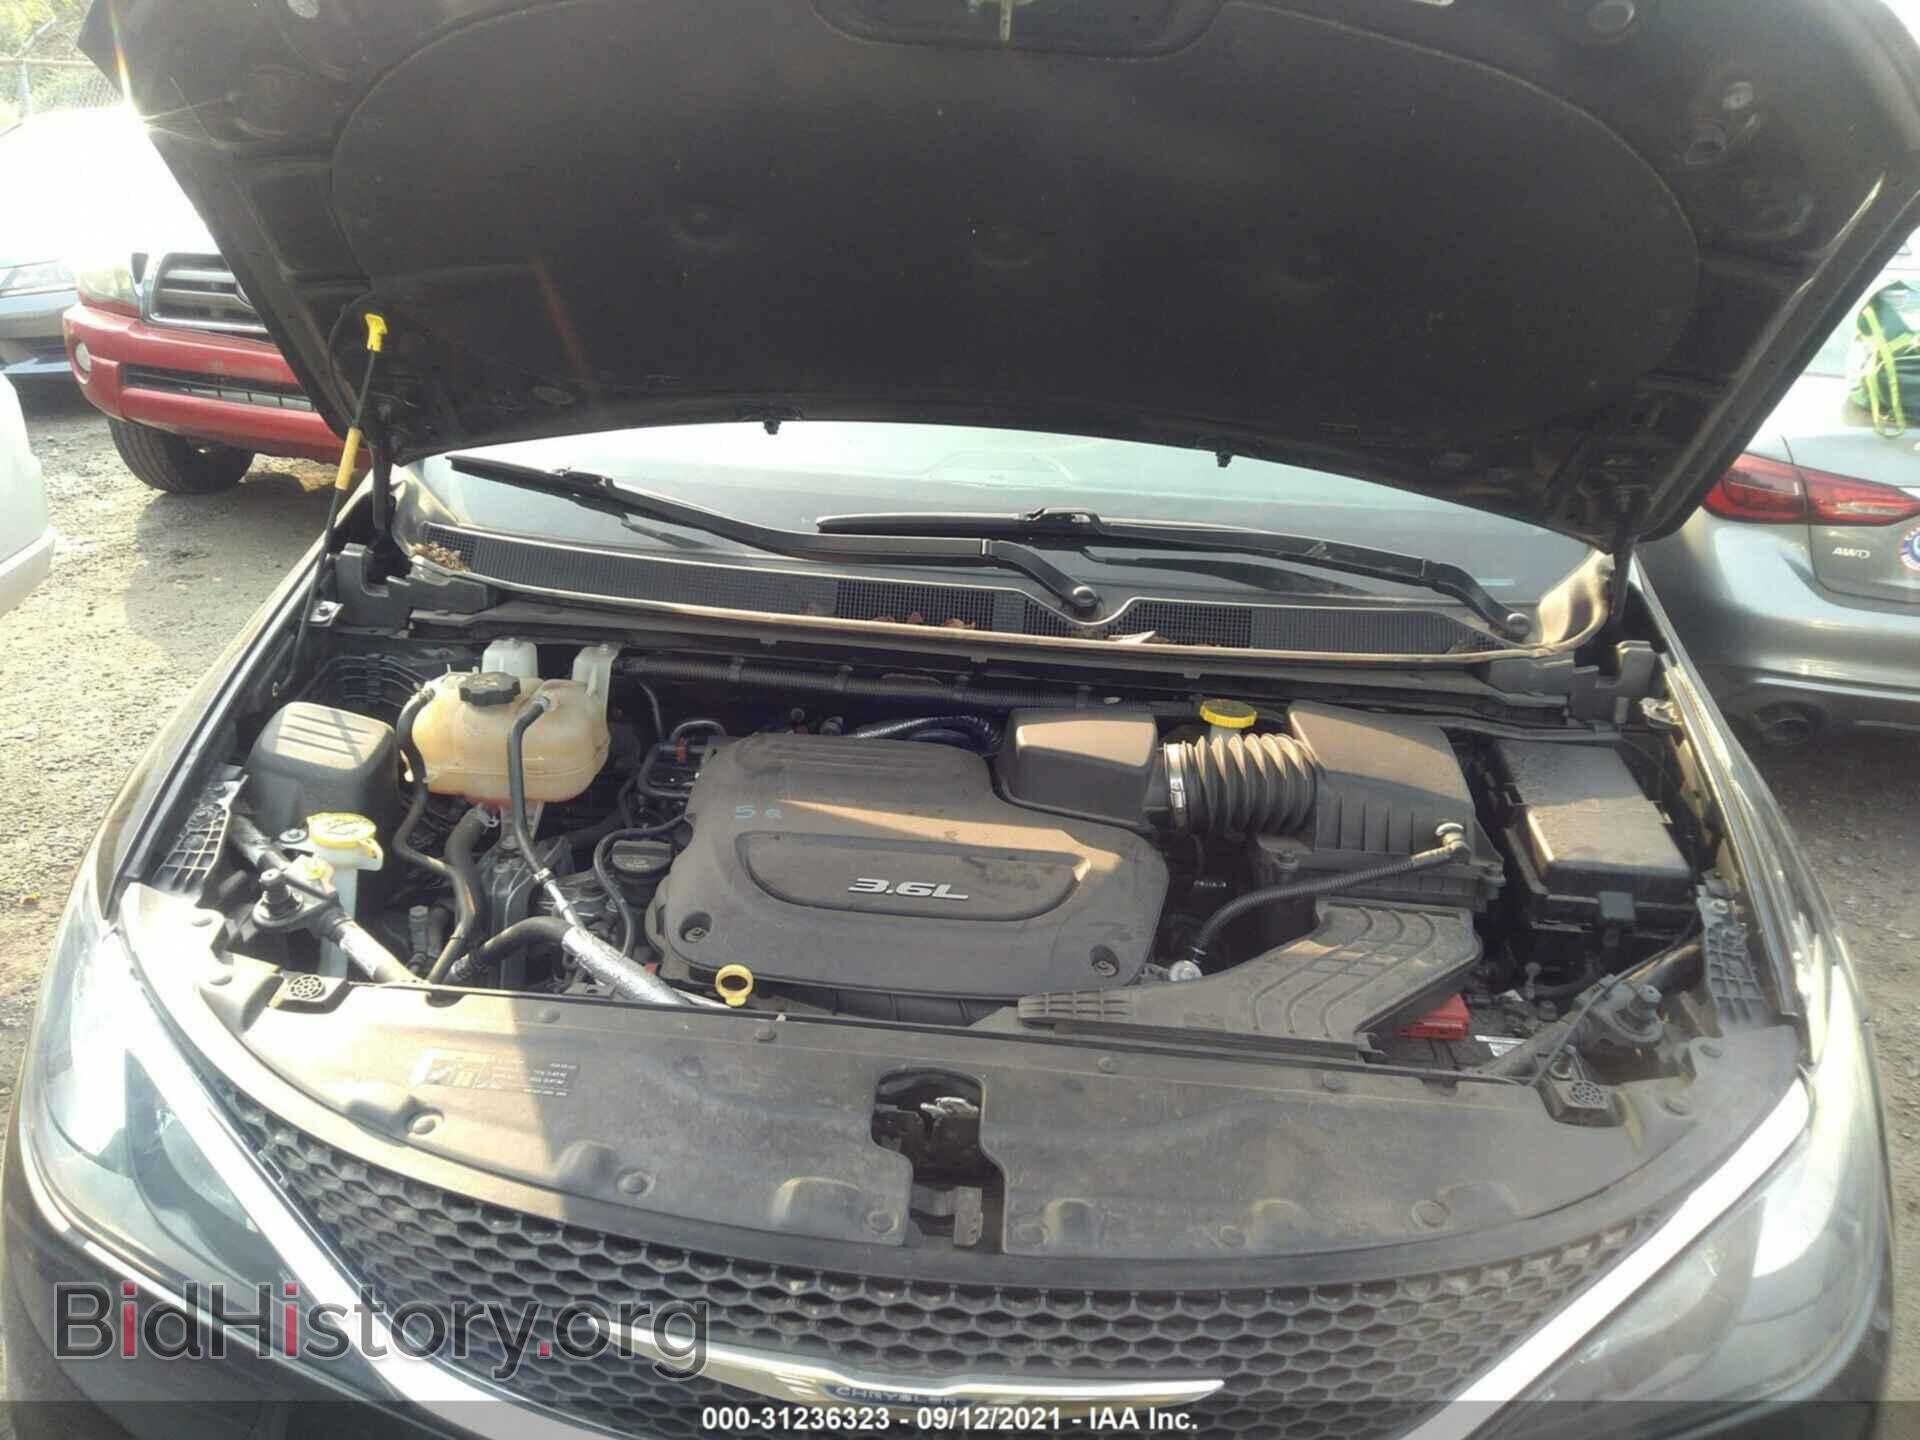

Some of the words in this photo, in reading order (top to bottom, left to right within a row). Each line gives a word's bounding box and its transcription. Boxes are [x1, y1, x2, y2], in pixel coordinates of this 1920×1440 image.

[1832, 547, 1870, 559] AWD
[848, 878, 969, 900] 3.6L
[835, 1386, 957, 1406] CHRYSLER
